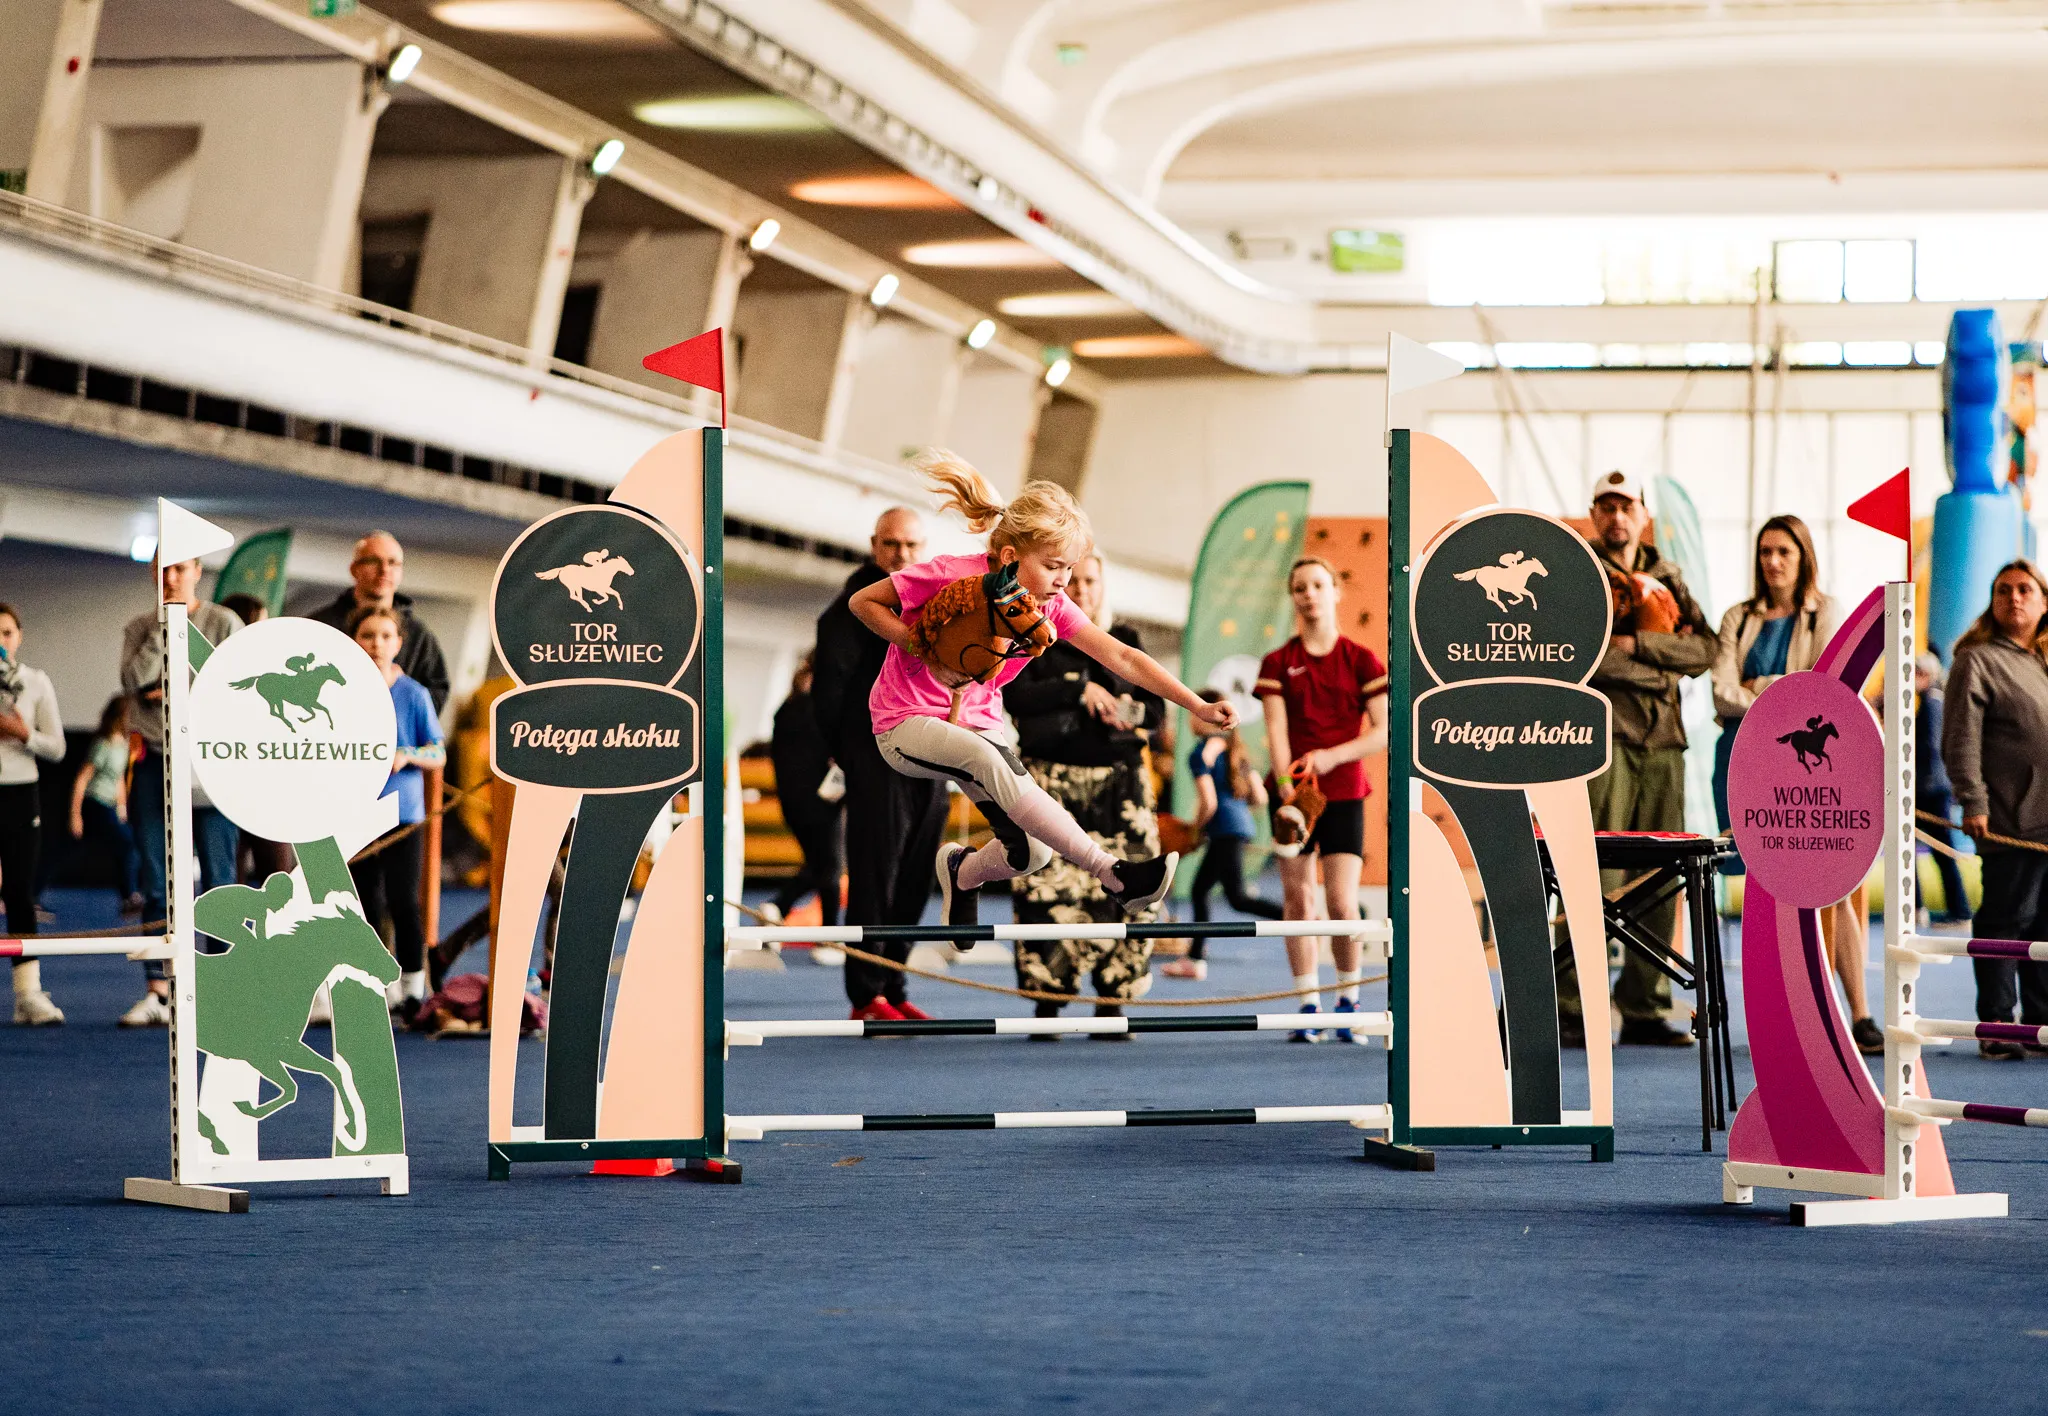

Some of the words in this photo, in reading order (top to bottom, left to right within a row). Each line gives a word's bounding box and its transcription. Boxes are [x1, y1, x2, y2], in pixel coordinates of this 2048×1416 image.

[571, 623, 618, 641] TOR
[1487, 622, 1532, 641] TOR
[510, 720, 598, 755] Potęga
[602, 723, 680, 748] skoku
[1431, 718, 1515, 752] Potęga
[1518, 720, 1593, 745] skoku
[197, 741, 248, 760] TOR
[257, 738, 388, 760] SŁUŻEWIEC
[1774, 786, 1841, 806] WOMEN
[1745, 808, 1806, 828] POWER
[1811, 809, 1871, 829] SERIES
[1761, 836, 1784, 849] TOR
